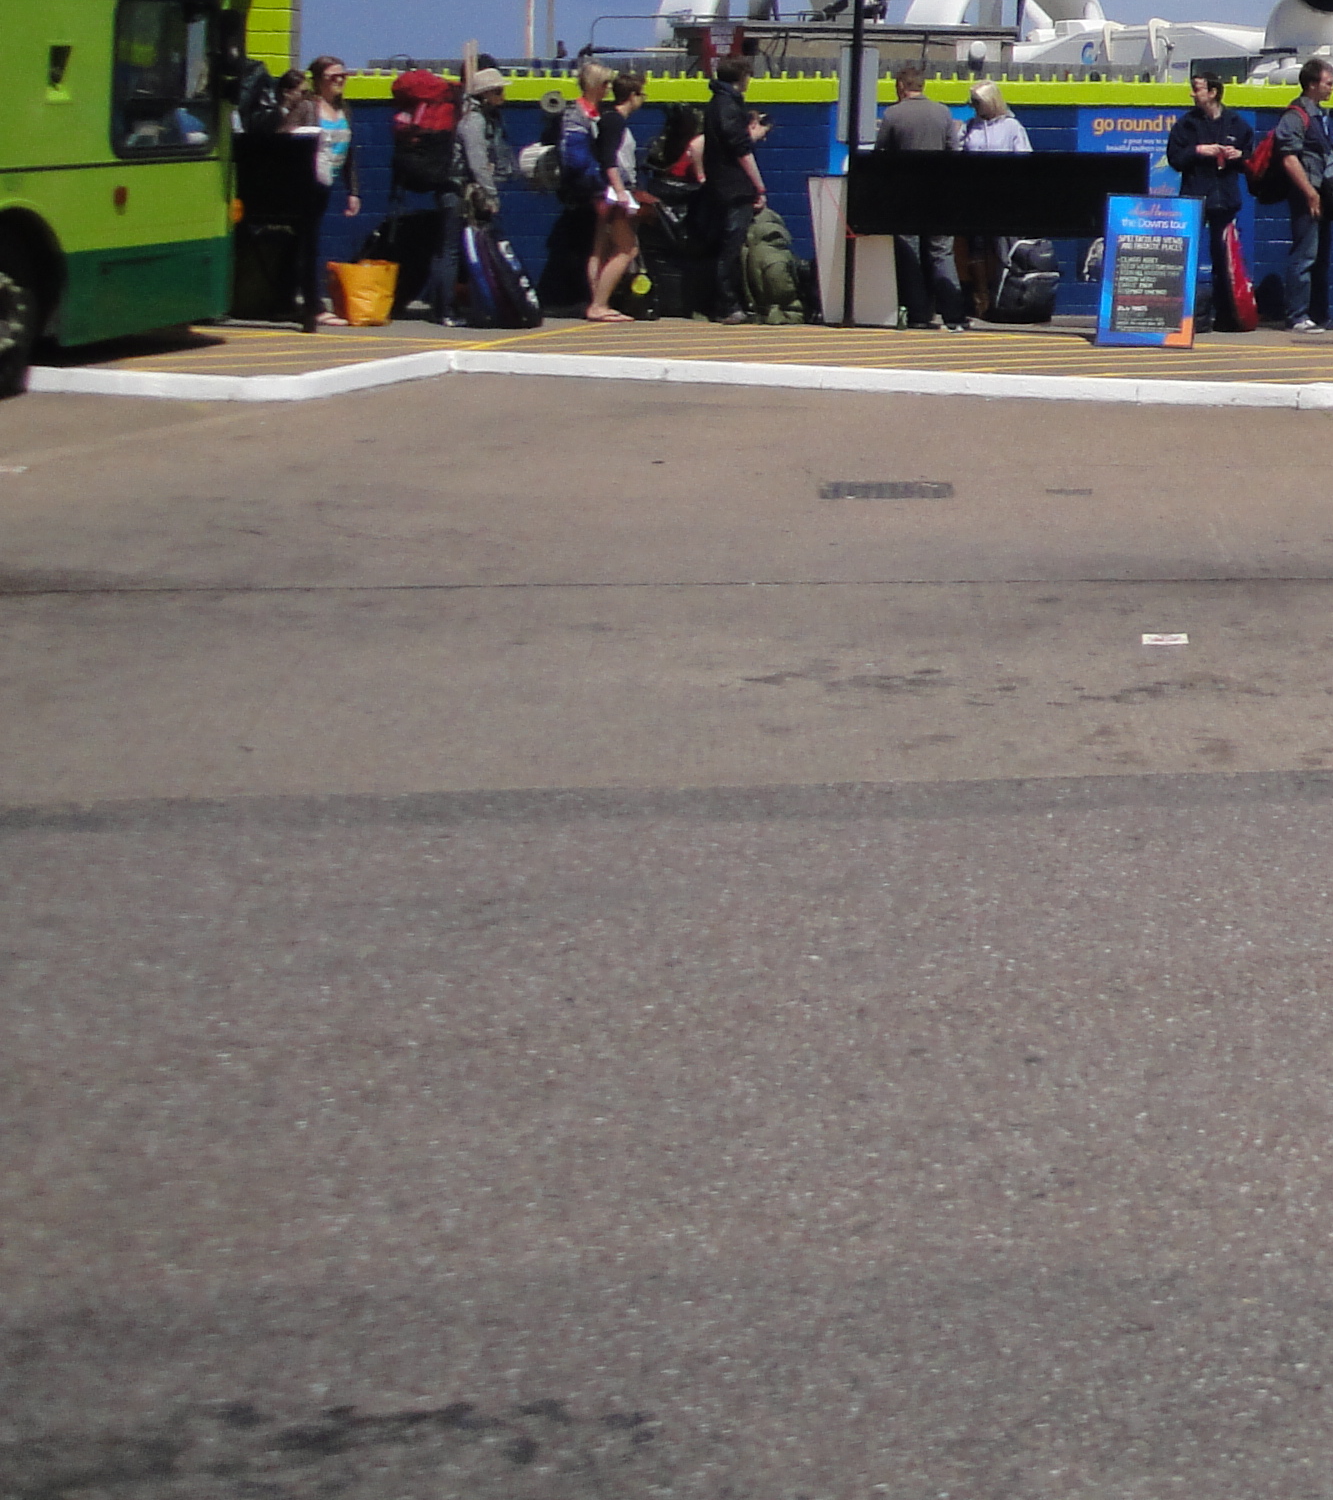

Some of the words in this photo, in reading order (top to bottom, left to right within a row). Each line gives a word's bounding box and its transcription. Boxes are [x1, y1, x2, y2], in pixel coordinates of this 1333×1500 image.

[1092, 118, 1115, 136] go
[1117, 115, 1164, 131] round
[1139, 219, 1169, 229] Downs
[1170, 220, 1188, 230] tour
